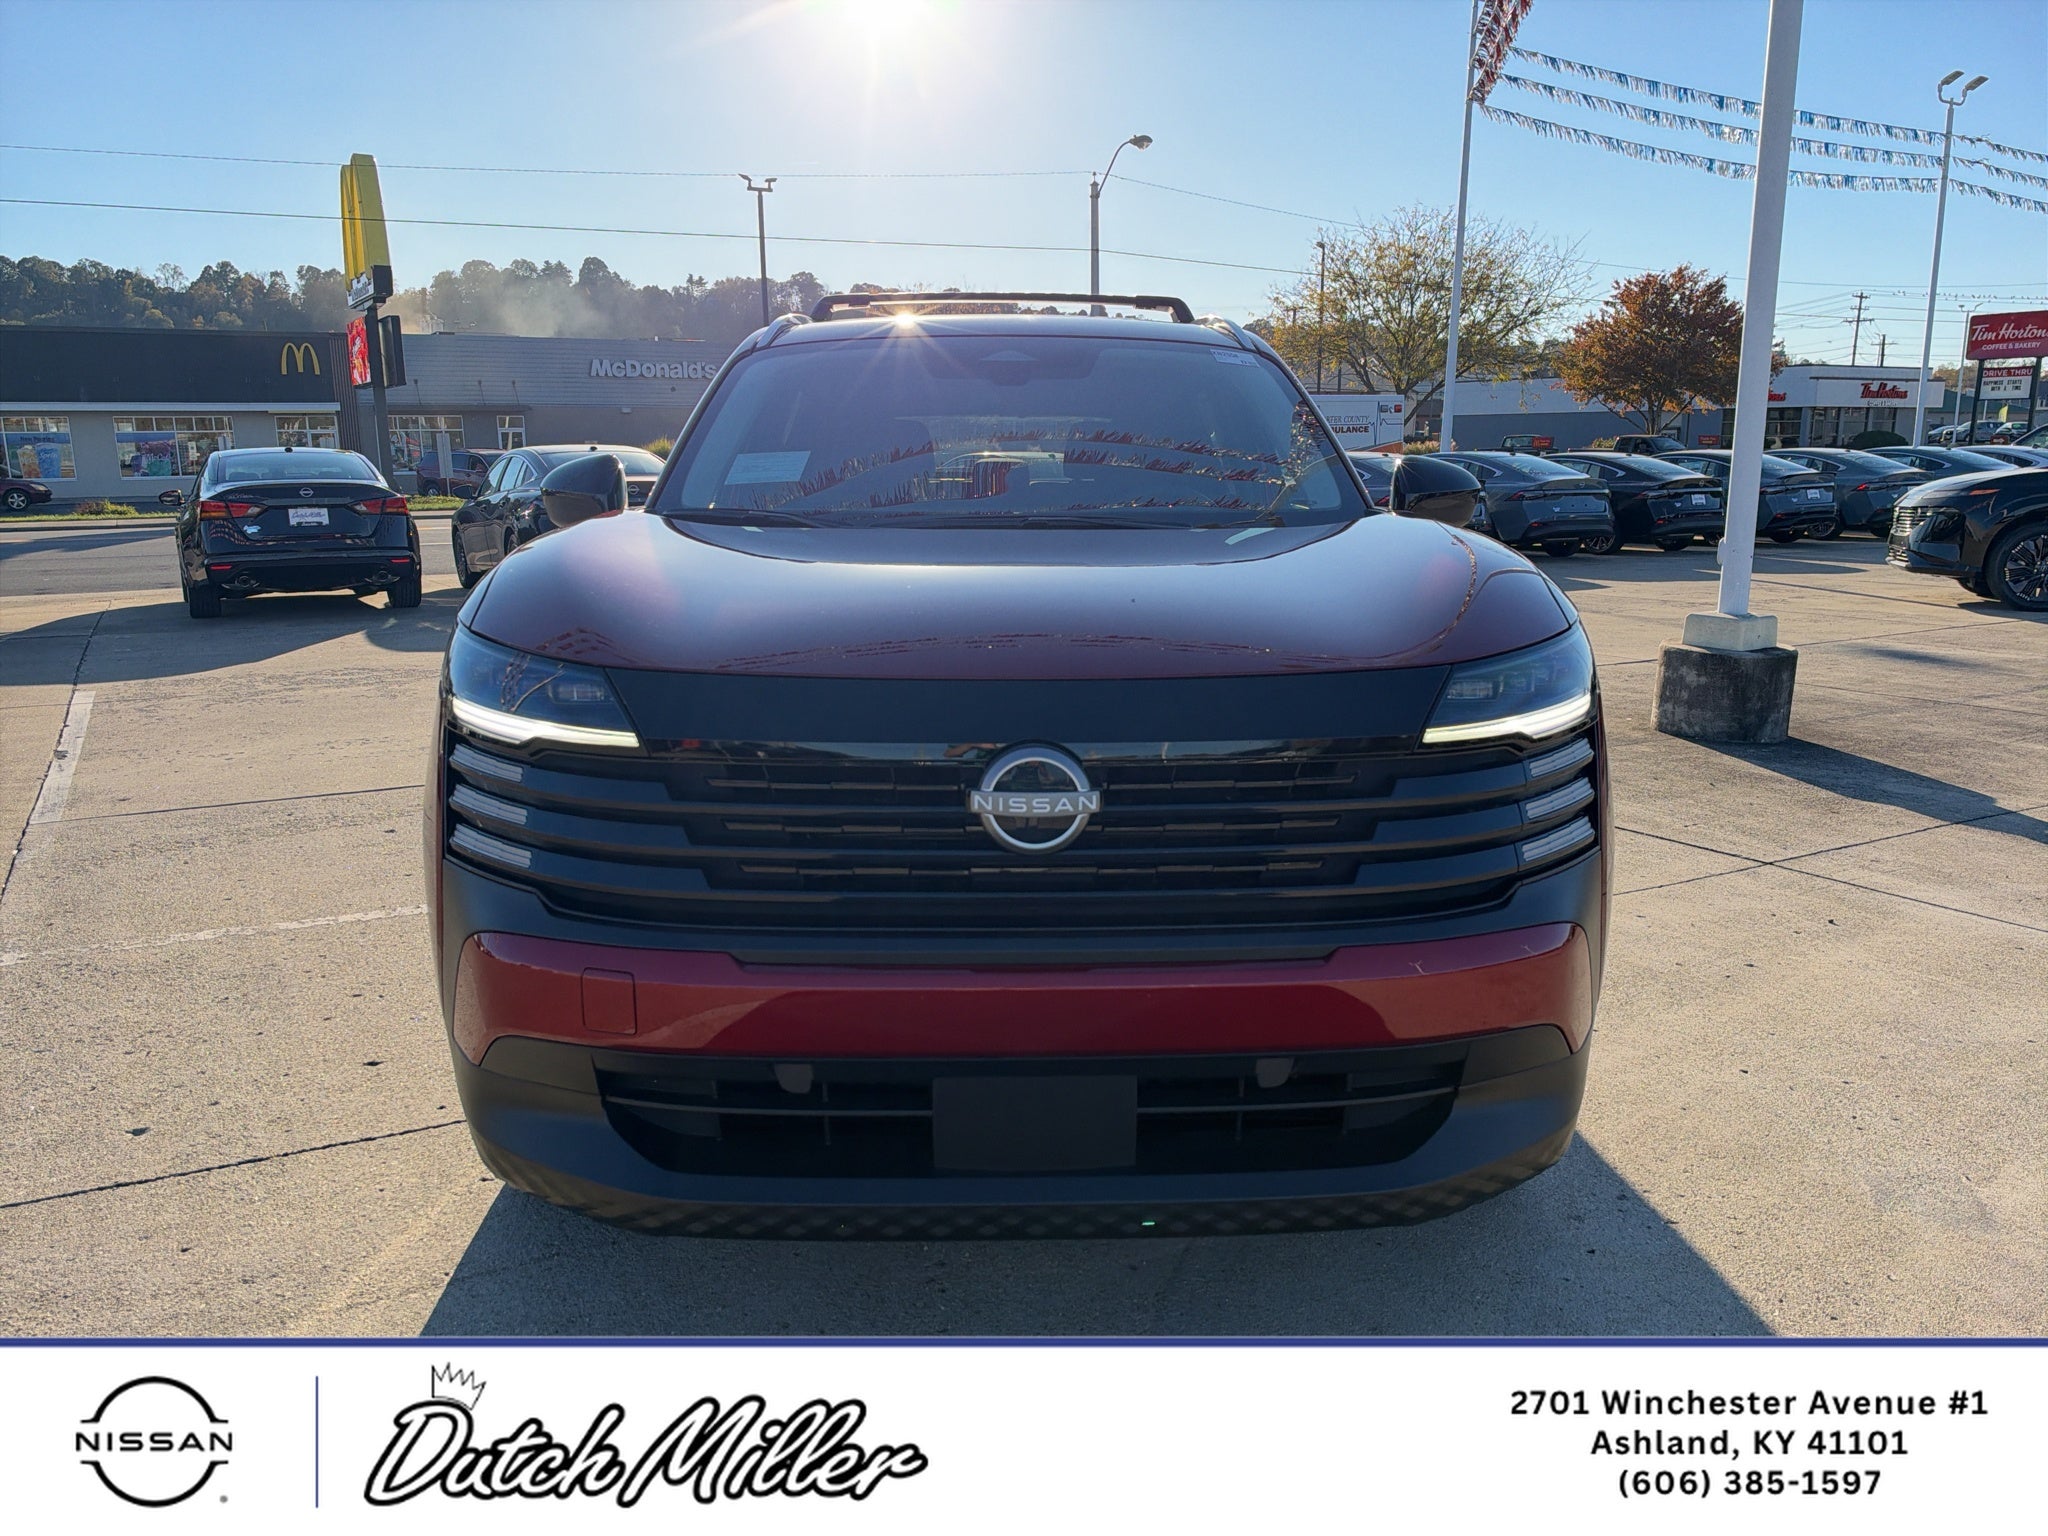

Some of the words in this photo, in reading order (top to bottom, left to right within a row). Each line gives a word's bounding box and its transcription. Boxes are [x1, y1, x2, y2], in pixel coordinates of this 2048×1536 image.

[1972, 325, 1997, 341] Tim
[1998, 322, 2048, 341] Horton
[1981, 343, 2008, 351] COFFEE
[2014, 341, 2041, 350] BAKERY
[590, 359, 718, 380] McDonald's
[1982, 369, 2009, 377] DRIVE
[2010, 367, 2033, 376] THRU
[1343, 415, 1370, 423] COUNTY
[973, 794, 1098, 813] NISSAN
